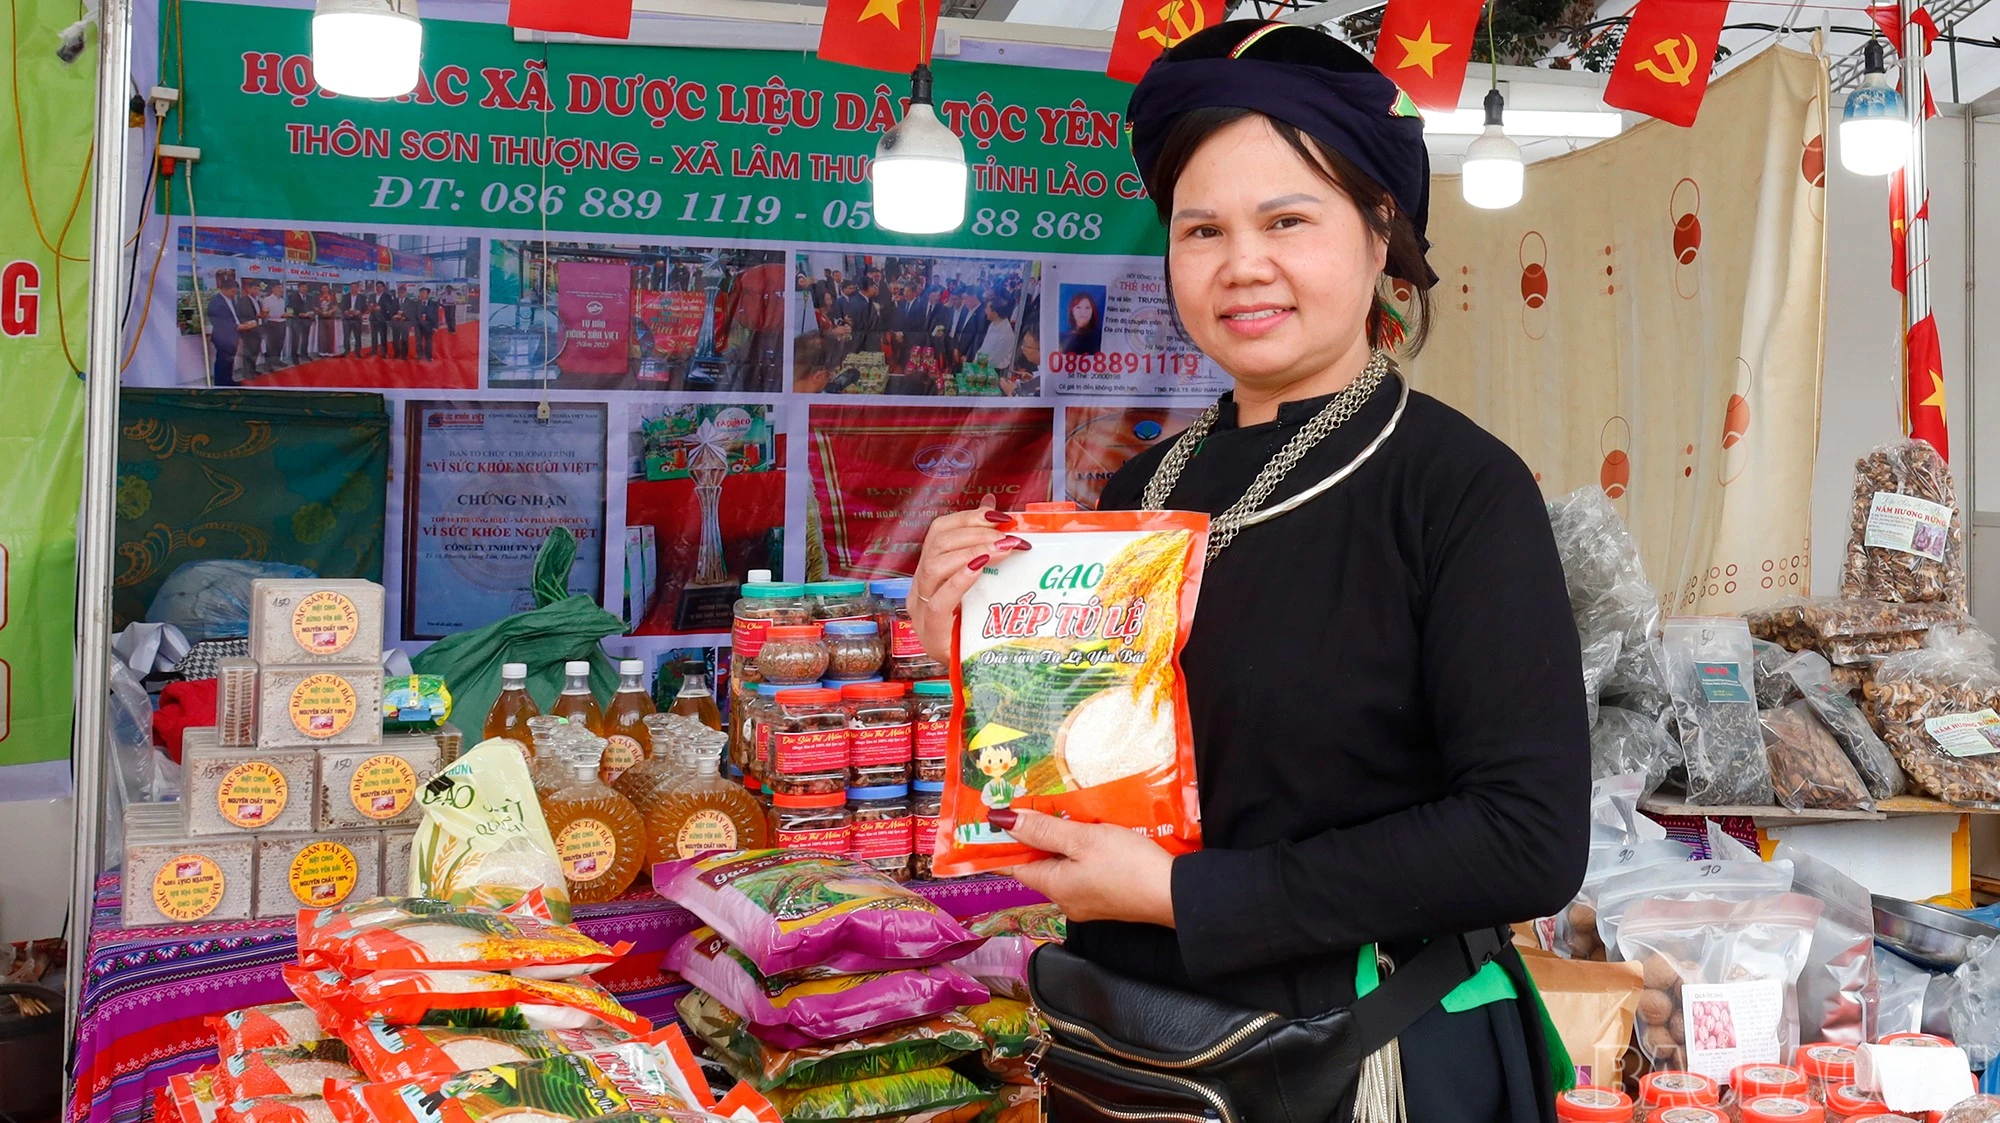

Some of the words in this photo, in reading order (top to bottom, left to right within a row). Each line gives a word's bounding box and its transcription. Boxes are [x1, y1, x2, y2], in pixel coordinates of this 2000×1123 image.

[241, 51, 336, 107] HỢ
[480, 59, 555, 113] XÃ
[566, 73, 706, 128] DƯỢC
[717, 75, 823, 135] LIỆU
[833, 84, 911, 132] DÂ
[941, 91, 1027, 149] TỘC
[1036, 98, 1120, 149] YÊN
[286, 119, 390, 158] THÔN
[400, 130, 479, 163] SƠN
[489, 135, 640, 175] THƯỢNG
[671, 141, 723, 176] XÃ
[732, 143, 800, 179] LÂM
[808, 154, 873, 183] THƯ
[972, 155, 1037, 193] TỈNH
[1047, 161, 1107, 197] LÀO
[369, 176, 464, 210] ĐT:
[481, 182, 566, 215] 086
[579, 187, 662, 219] 889
[677, 192, 781, 225] 1119
[1032, 211, 1102, 240] 868
[1048, 351, 1199, 375] 0868891119
[457, 492, 517, 506] CHỨNG
[983, 567, 998, 575] UNG
[1039, 562, 1105, 597] GẠO
[272, 597, 291, 607] 150
[982, 591, 1053, 639] NẾP
[1056, 595, 1103, 638] TÚ
[1102, 595, 1147, 645] LỆ
[1086, 650, 1116, 667] Yên
[1120, 649, 1146, 664] Bái
[333, 758, 352, 772] 150
[1157, 823, 1174, 838] 1KG
[1618, 849, 1634, 863] 90
[1701, 865, 1721, 877] 90
